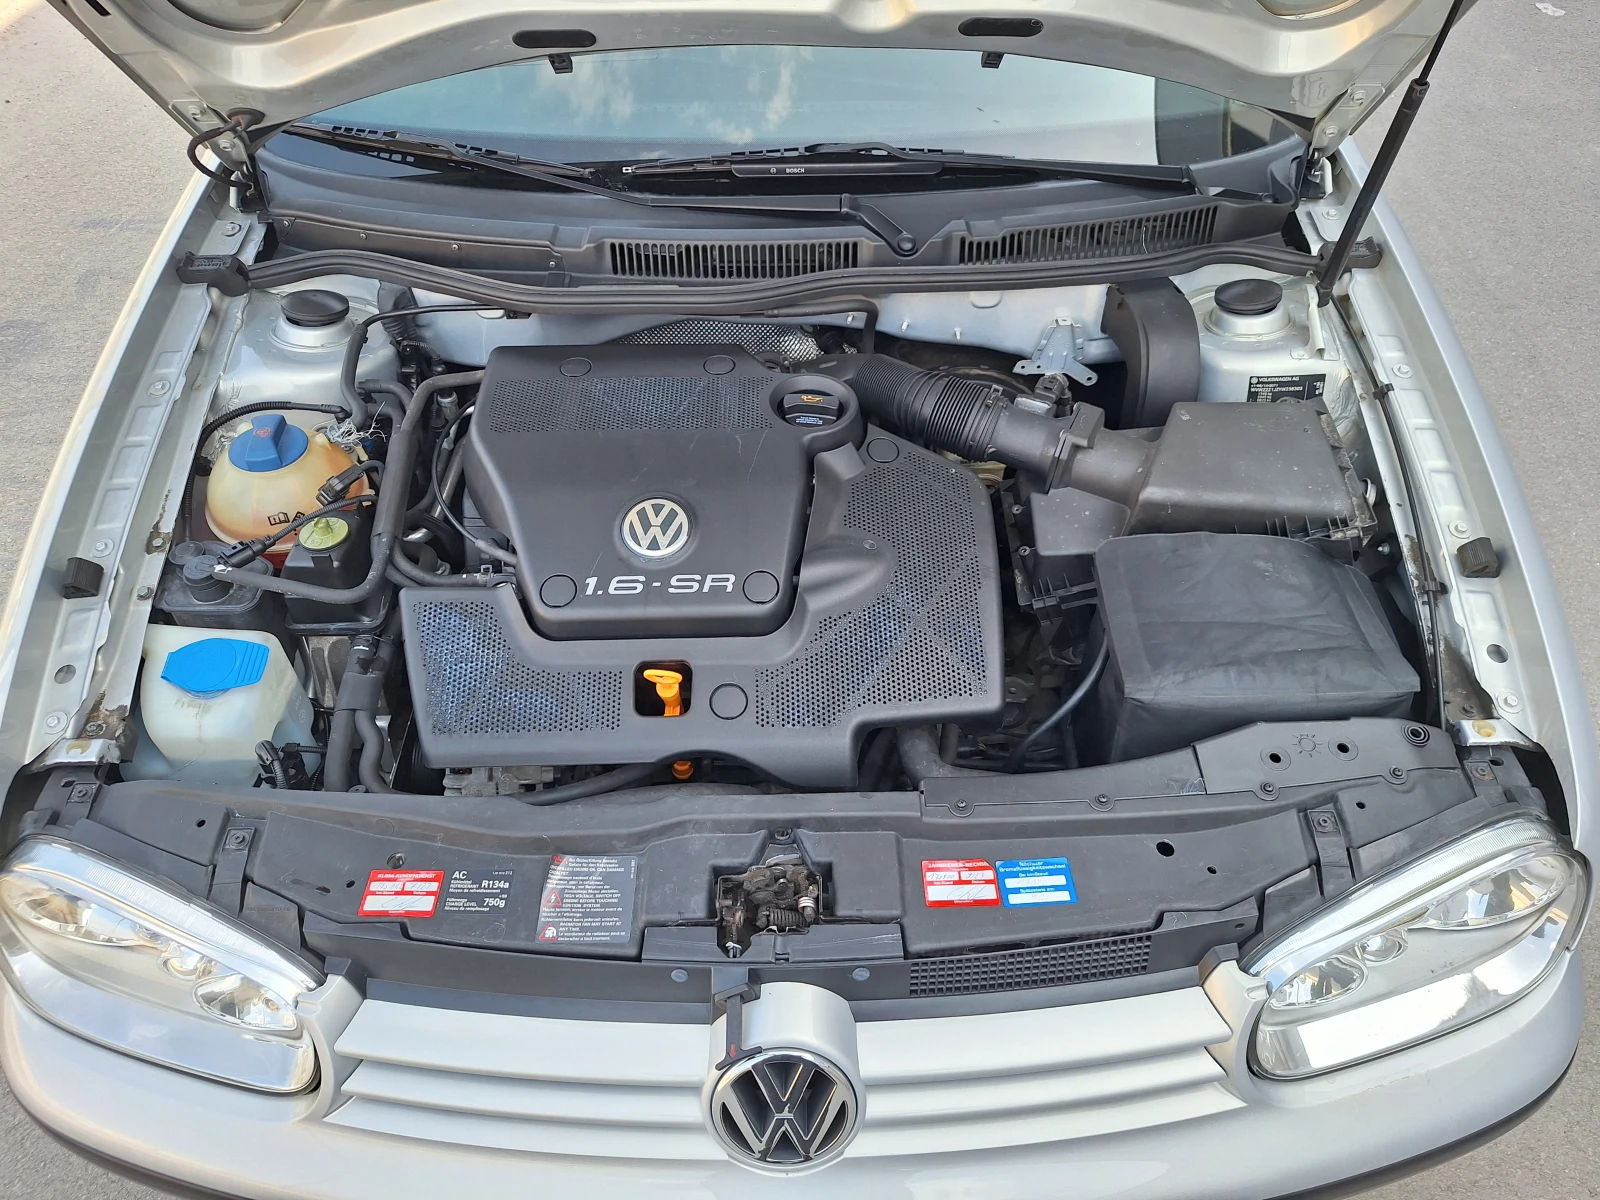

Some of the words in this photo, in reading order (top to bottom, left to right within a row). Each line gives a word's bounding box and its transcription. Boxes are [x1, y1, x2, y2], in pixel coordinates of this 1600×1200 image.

[452, 871, 467, 879] AC
[481, 880, 509, 888] R134a
[484, 898, 506, 908] 750g
